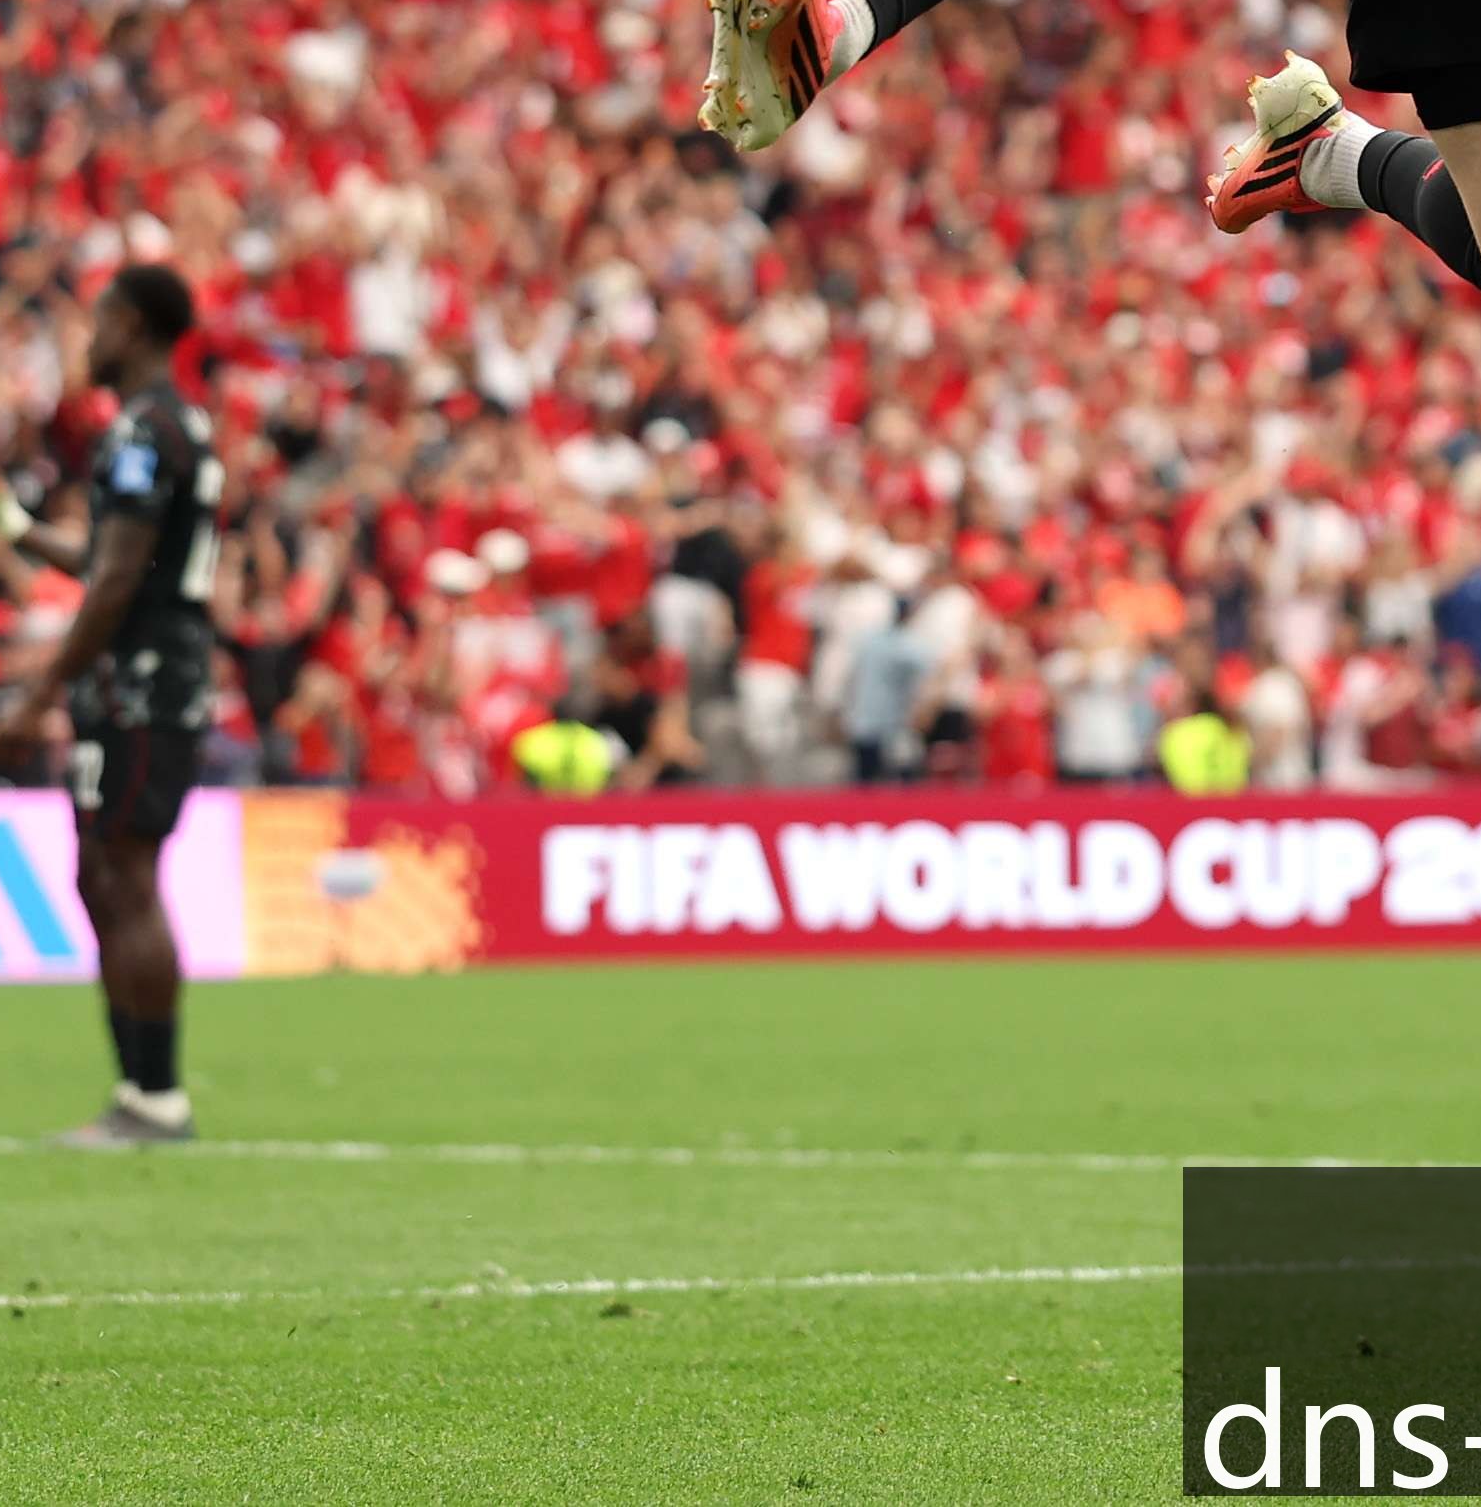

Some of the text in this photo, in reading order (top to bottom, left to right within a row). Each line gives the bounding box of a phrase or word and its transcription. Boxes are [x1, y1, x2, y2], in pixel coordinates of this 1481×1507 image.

[540, 823, 783, 934] FIFA
[776, 819, 1167, 932] WORLD
[1166, 817, 1382, 929] CUP
